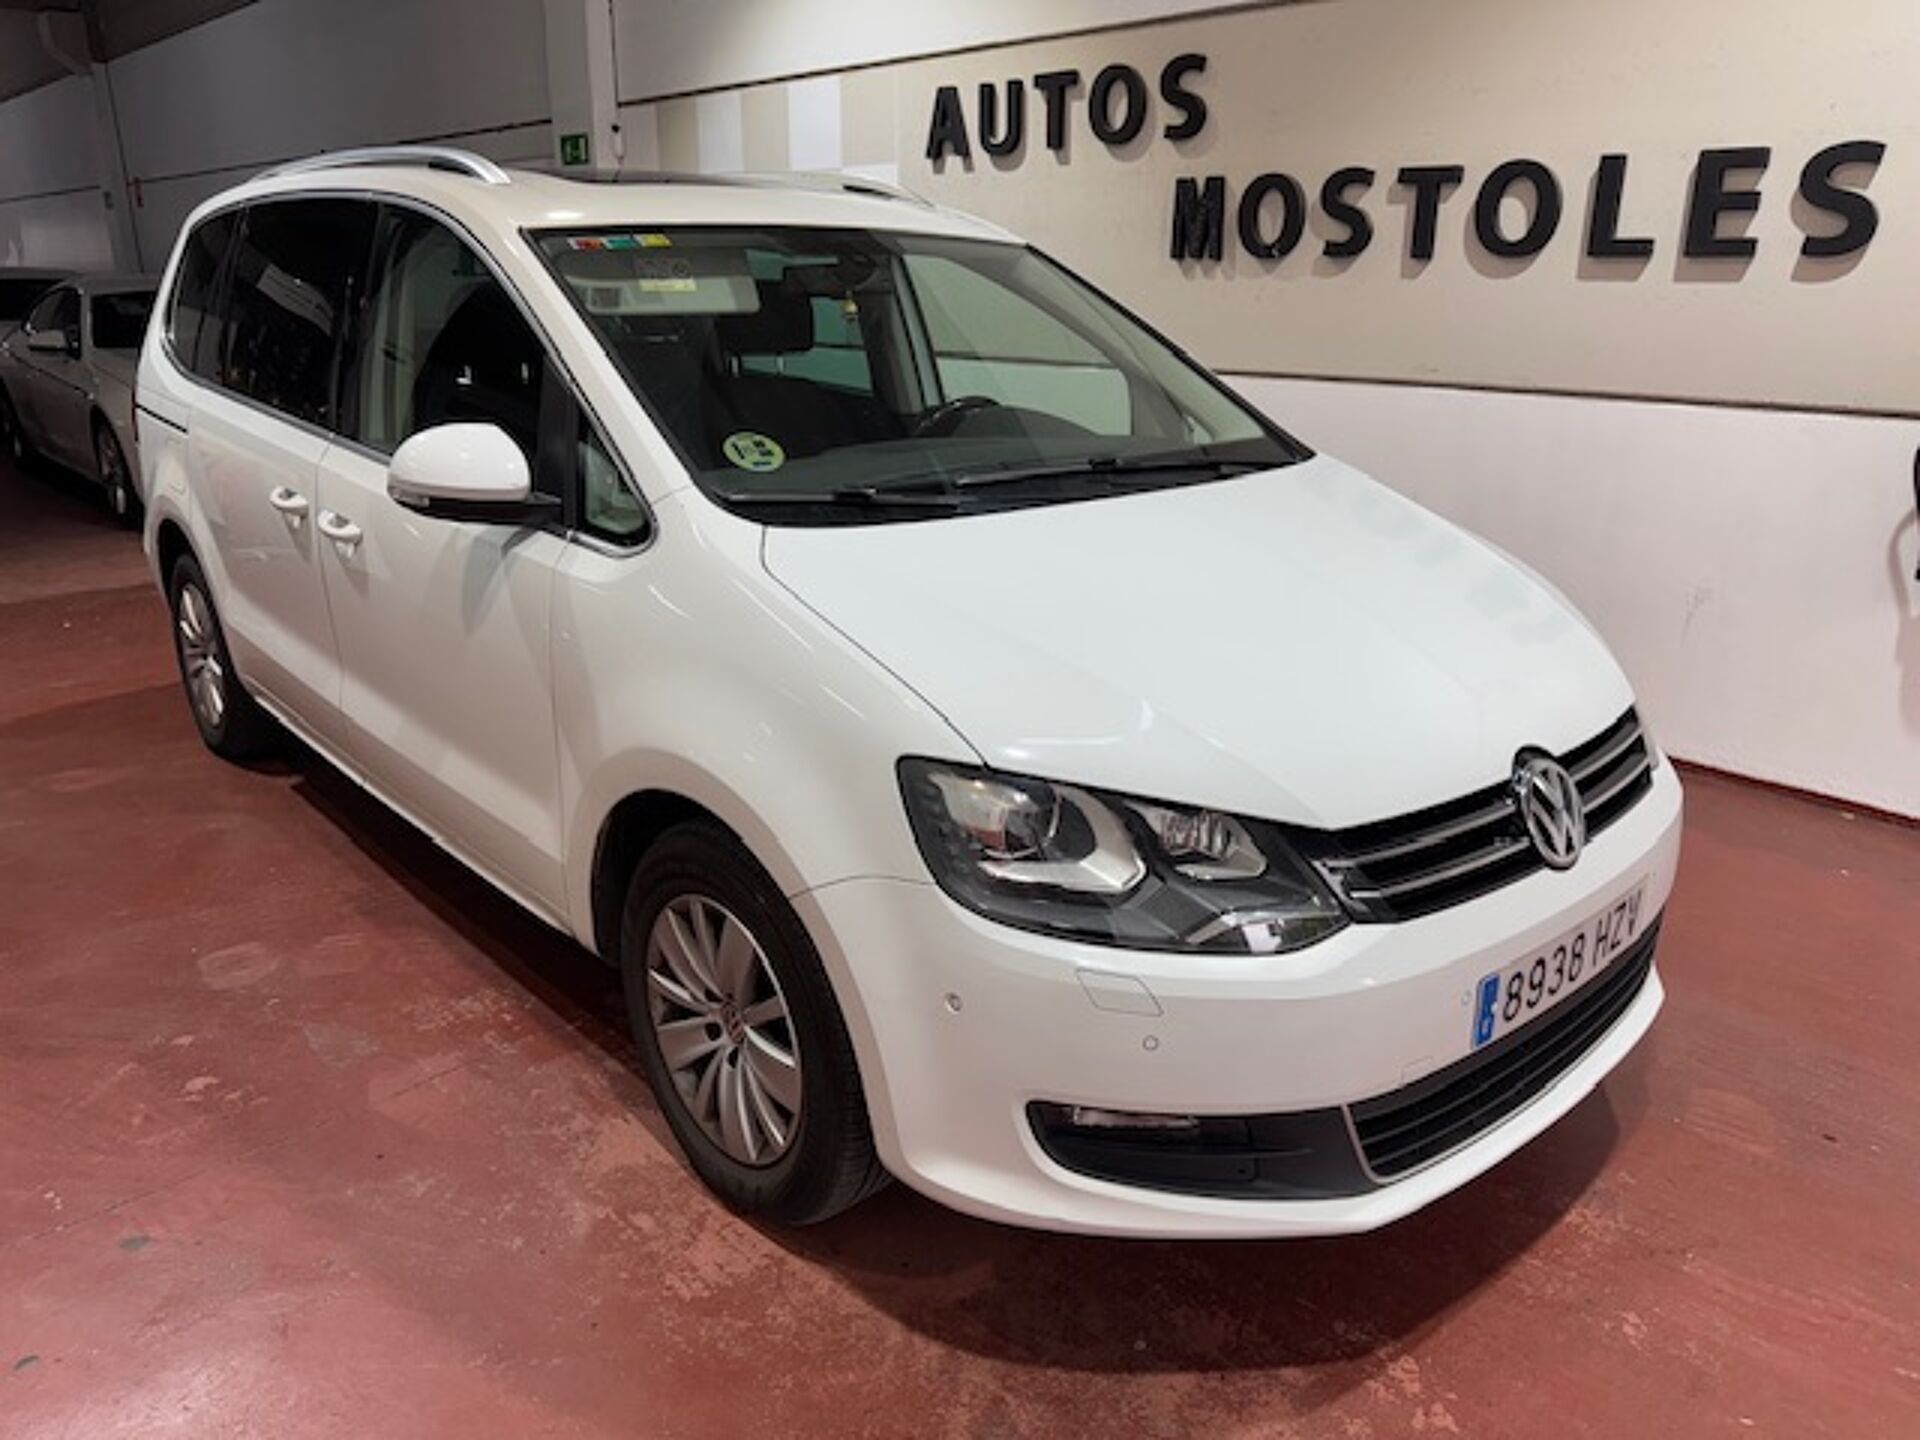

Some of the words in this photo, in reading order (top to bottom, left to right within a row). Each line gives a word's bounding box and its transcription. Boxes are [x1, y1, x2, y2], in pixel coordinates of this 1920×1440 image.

[926, 54, 1208, 161] AUTOS
[1170, 140, 1887, 262] MOSTOLES
[1503, 932, 1585, 1022] 8938
